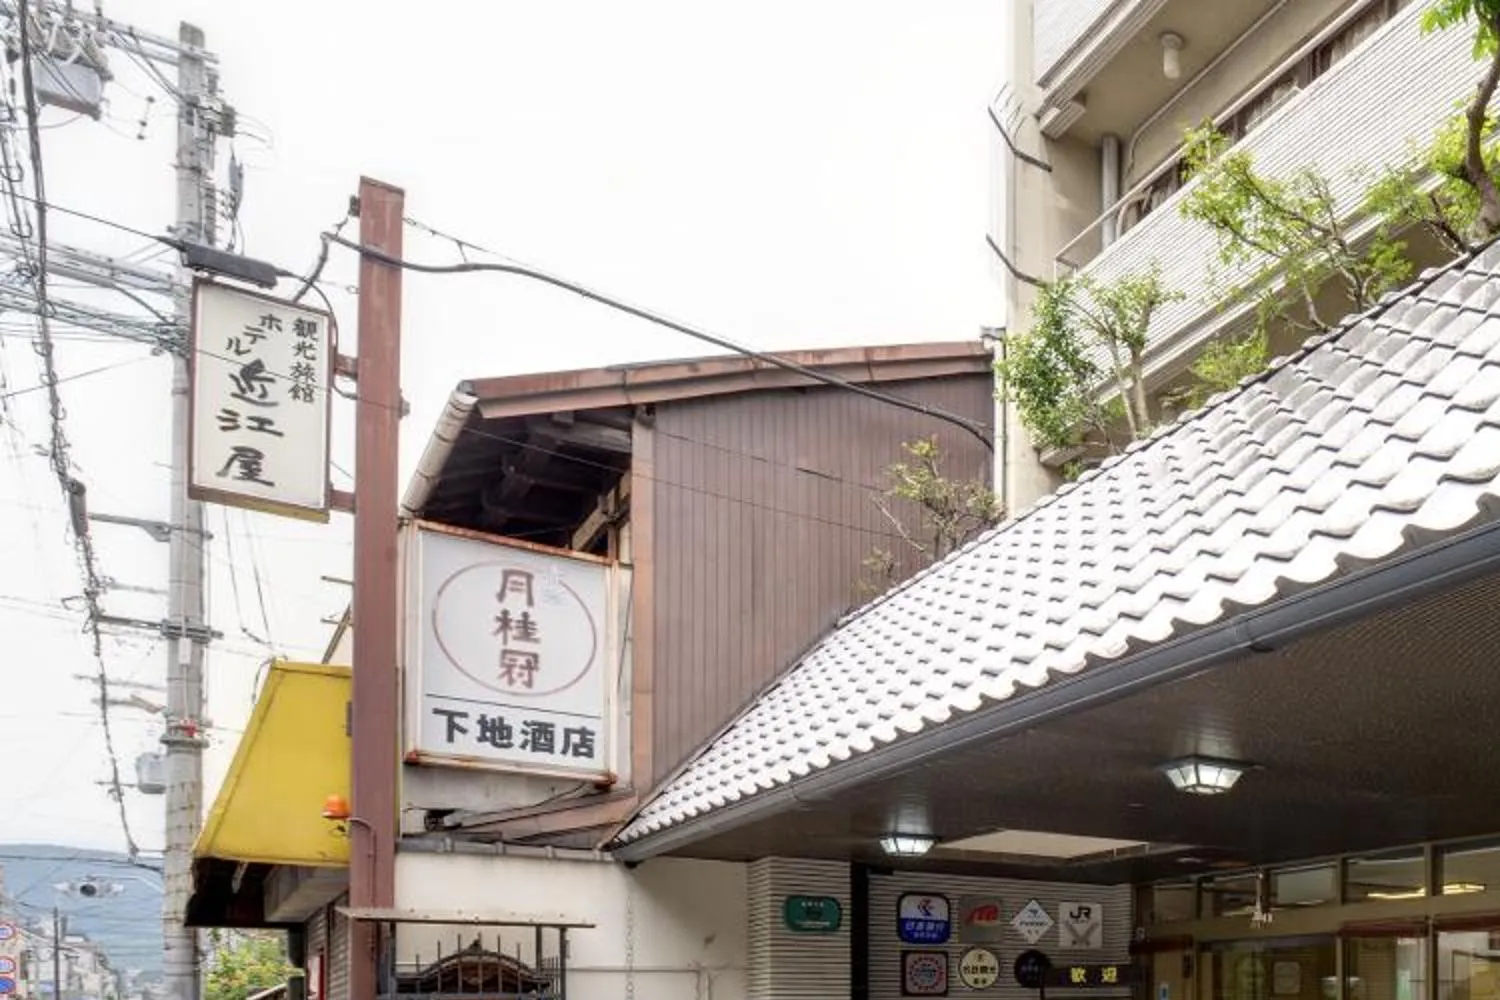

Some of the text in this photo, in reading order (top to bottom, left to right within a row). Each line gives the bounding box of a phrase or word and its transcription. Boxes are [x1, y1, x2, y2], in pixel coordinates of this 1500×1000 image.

[225, 313, 283, 357] ホテル
[288, 316, 320, 403] 観光旅館
[215, 358, 284, 488] 近江屋
[493, 568, 541, 690] 月桂冠
[431, 706, 596, 760] 下地酒店
[1069, 906, 1092, 920] JR
